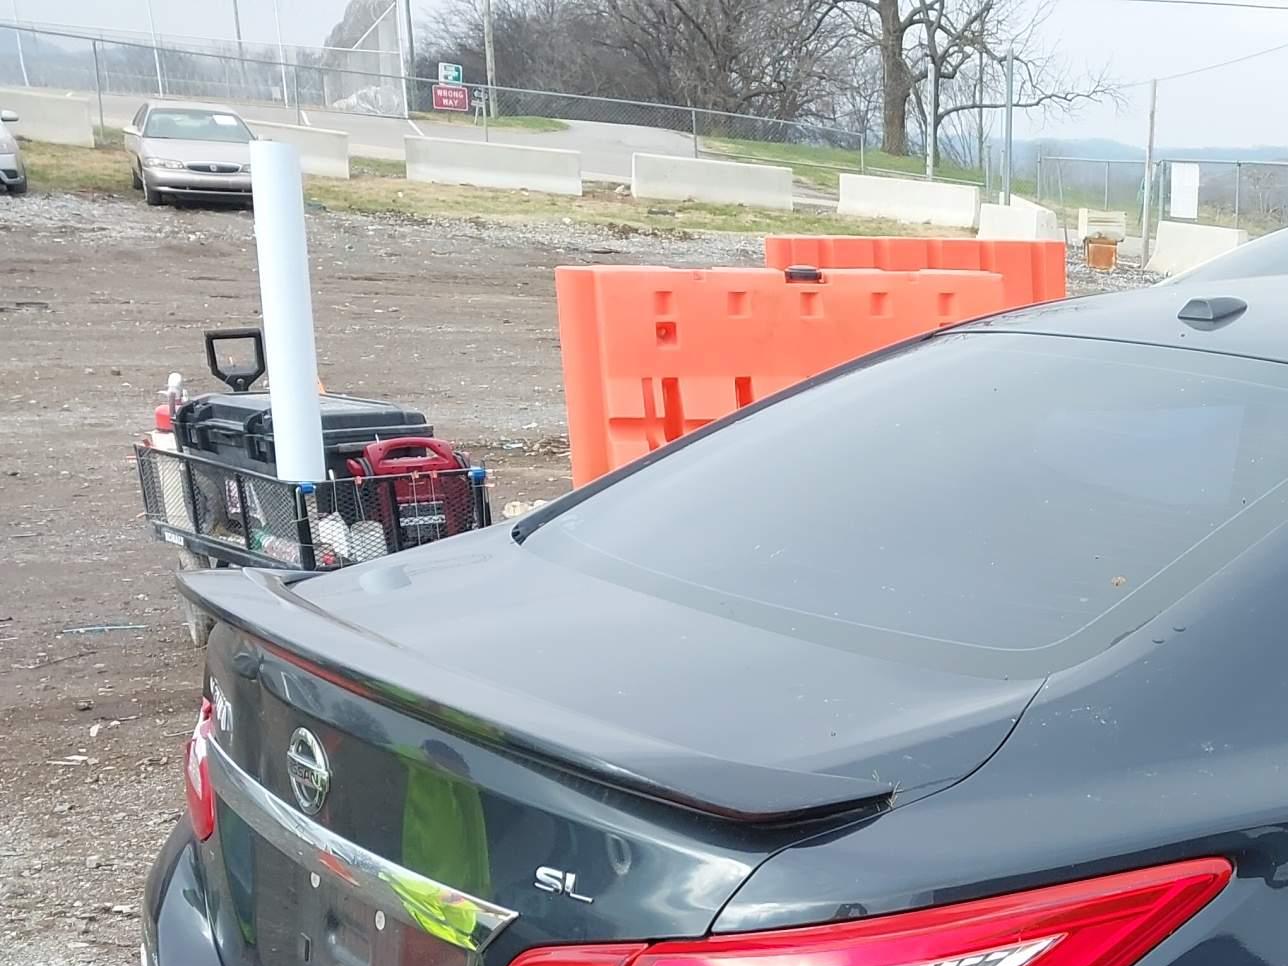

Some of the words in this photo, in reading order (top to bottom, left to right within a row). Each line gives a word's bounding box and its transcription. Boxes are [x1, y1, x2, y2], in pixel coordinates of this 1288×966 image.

[436, 89, 464, 98] WRONG
[442, 98, 459, 107] WAY
[534, 866, 593, 903] SL
